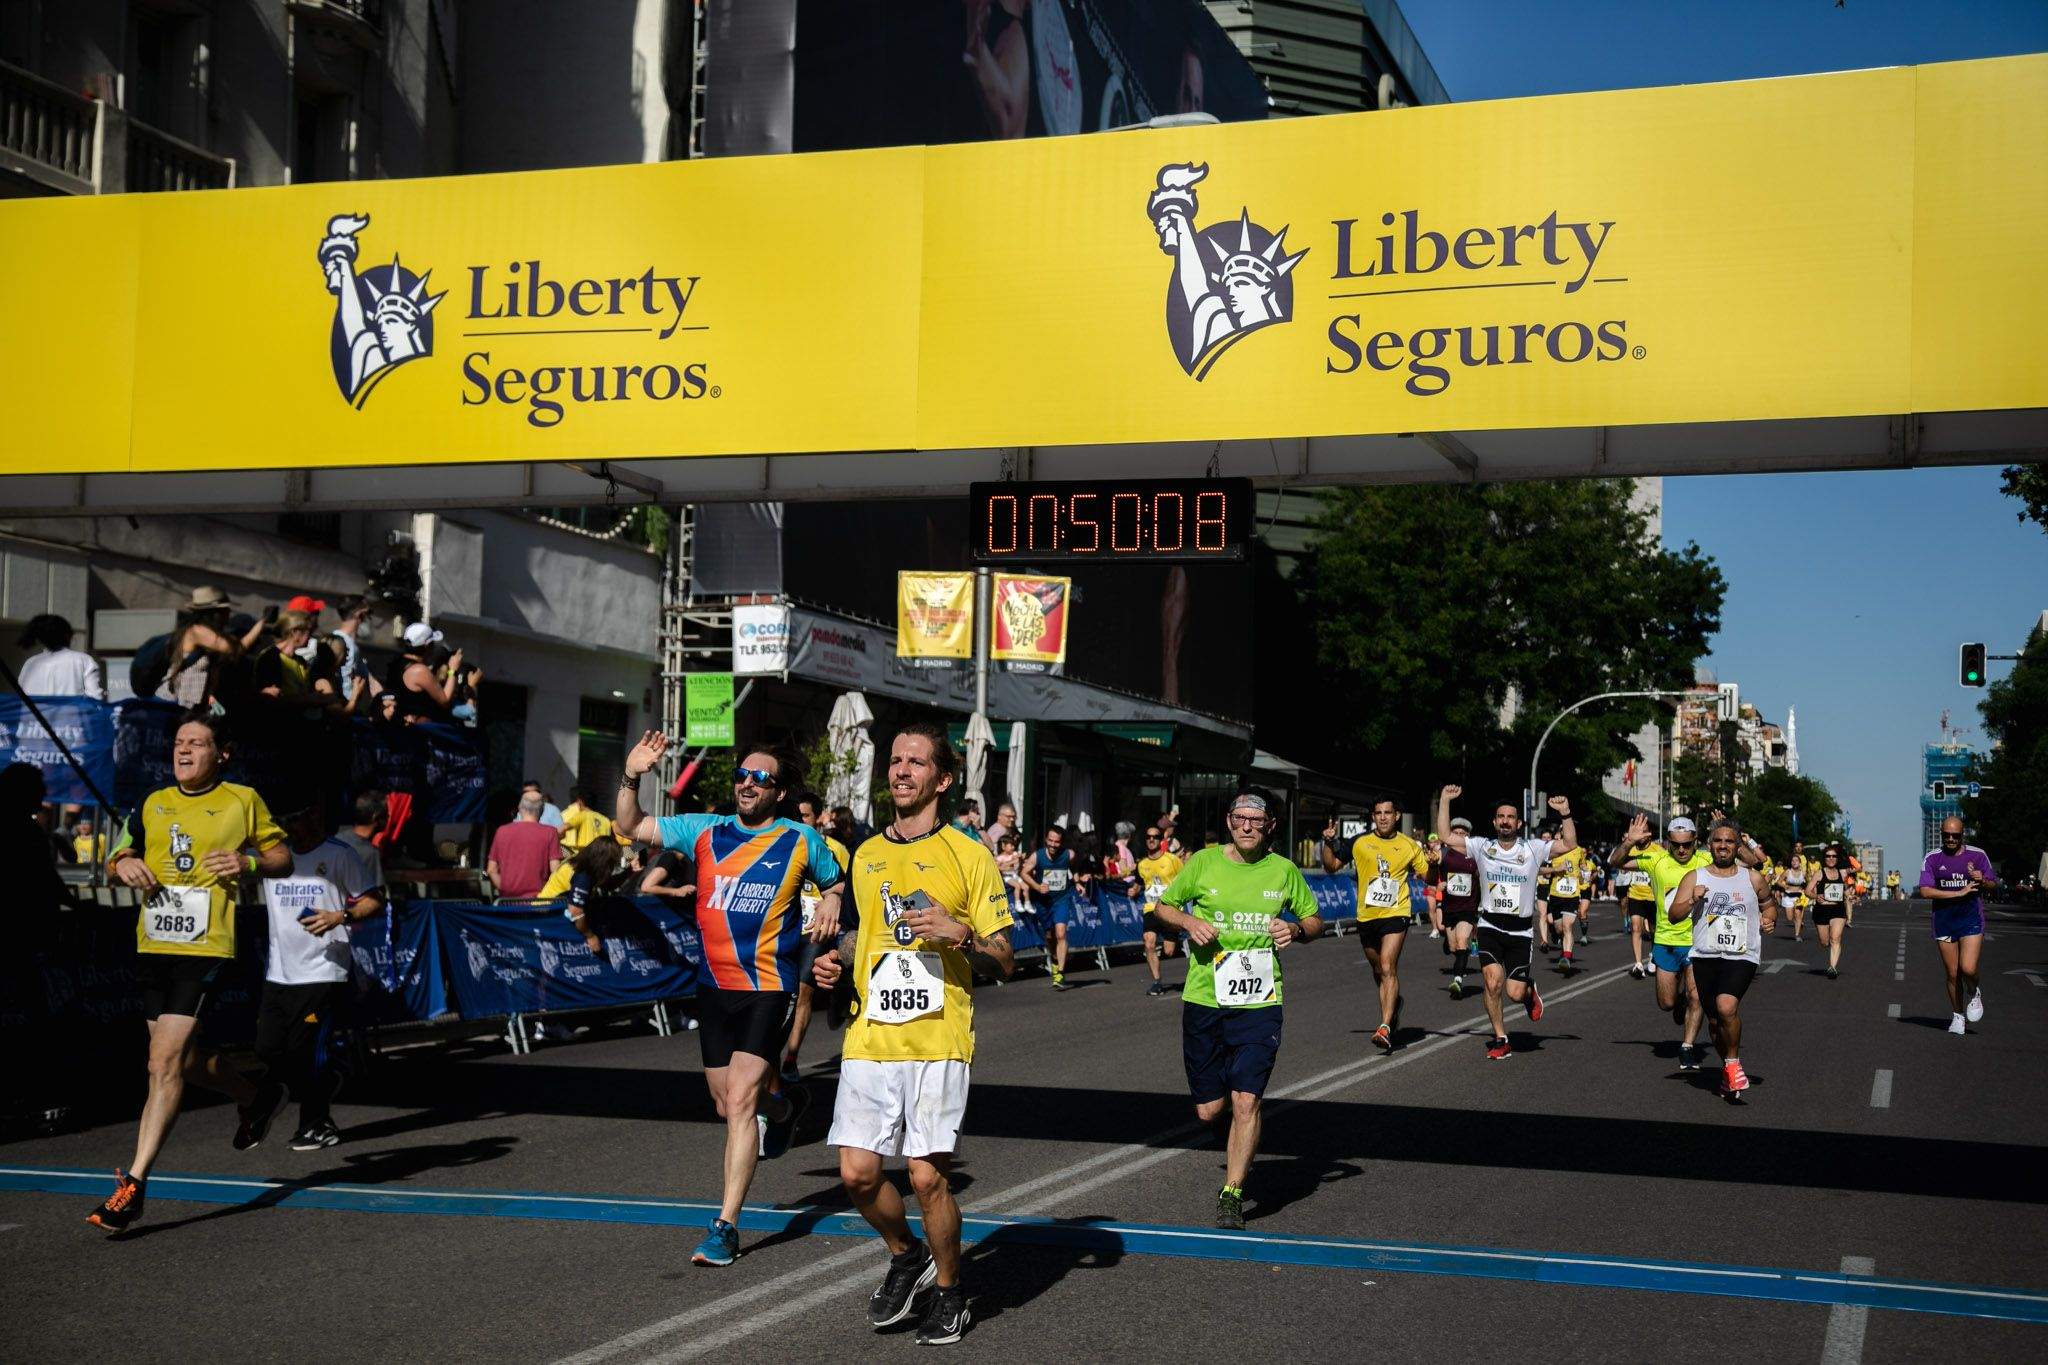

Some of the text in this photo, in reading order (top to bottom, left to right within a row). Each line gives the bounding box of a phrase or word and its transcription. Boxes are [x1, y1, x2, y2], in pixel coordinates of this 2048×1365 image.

[1331, 209, 1617, 294] Liberty
[465, 259, 701, 340] Liberty
[922, 659, 952, 667] MADRID
[1016, 662, 1045, 671] MADRID
[179, 857, 191, 869] 13
[1486, 871, 1528, 882] Emirates
[275, 882, 324, 895] Emirates
[1940, 879, 1968, 888] Emirat
[706, 874, 776, 911] XI CARRERA
[1373, 891, 1392, 903] 2227
[730, 897, 770, 914] LIBERTY
[1494, 898, 1513, 908] 1965
[154, 914, 196, 933] 2683
[1233, 911, 1272, 925] OXFA
[897, 926, 912, 940] 13
[1717, 933, 1737, 946] 657
[1228, 977, 1263, 996] 2472
[880, 988, 930, 1011] 3835
